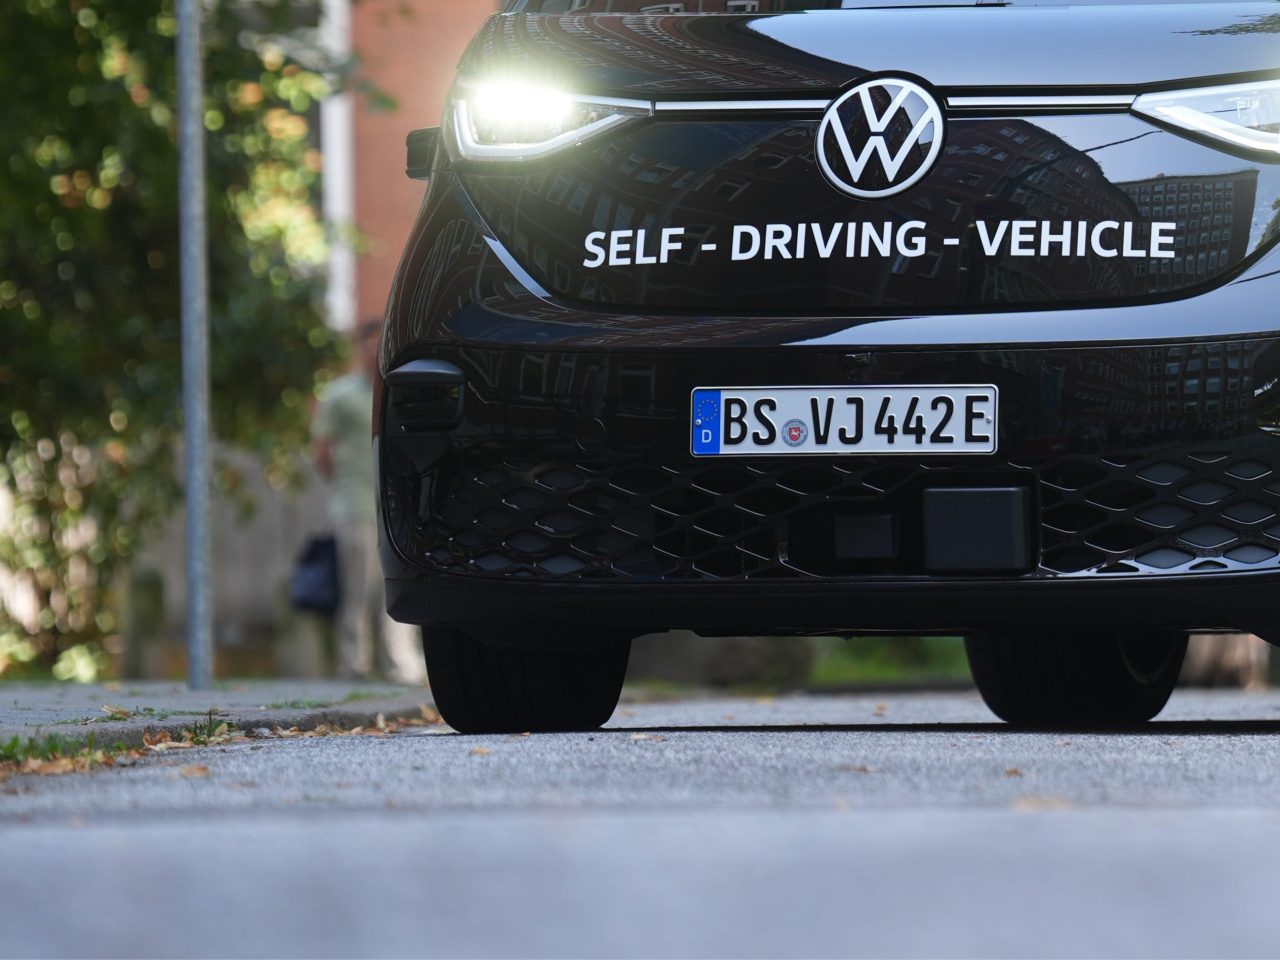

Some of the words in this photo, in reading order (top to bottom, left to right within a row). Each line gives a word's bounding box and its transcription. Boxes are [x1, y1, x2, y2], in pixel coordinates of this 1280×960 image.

[819, 79, 942, 193] VW
[582, 227, 686, 268] SELF
[731, 220, 927, 261] DRIVING
[975, 220, 1177, 258] VEHICLE
[701, 429, 712, 443] D
[723, 396, 778, 446] BS
